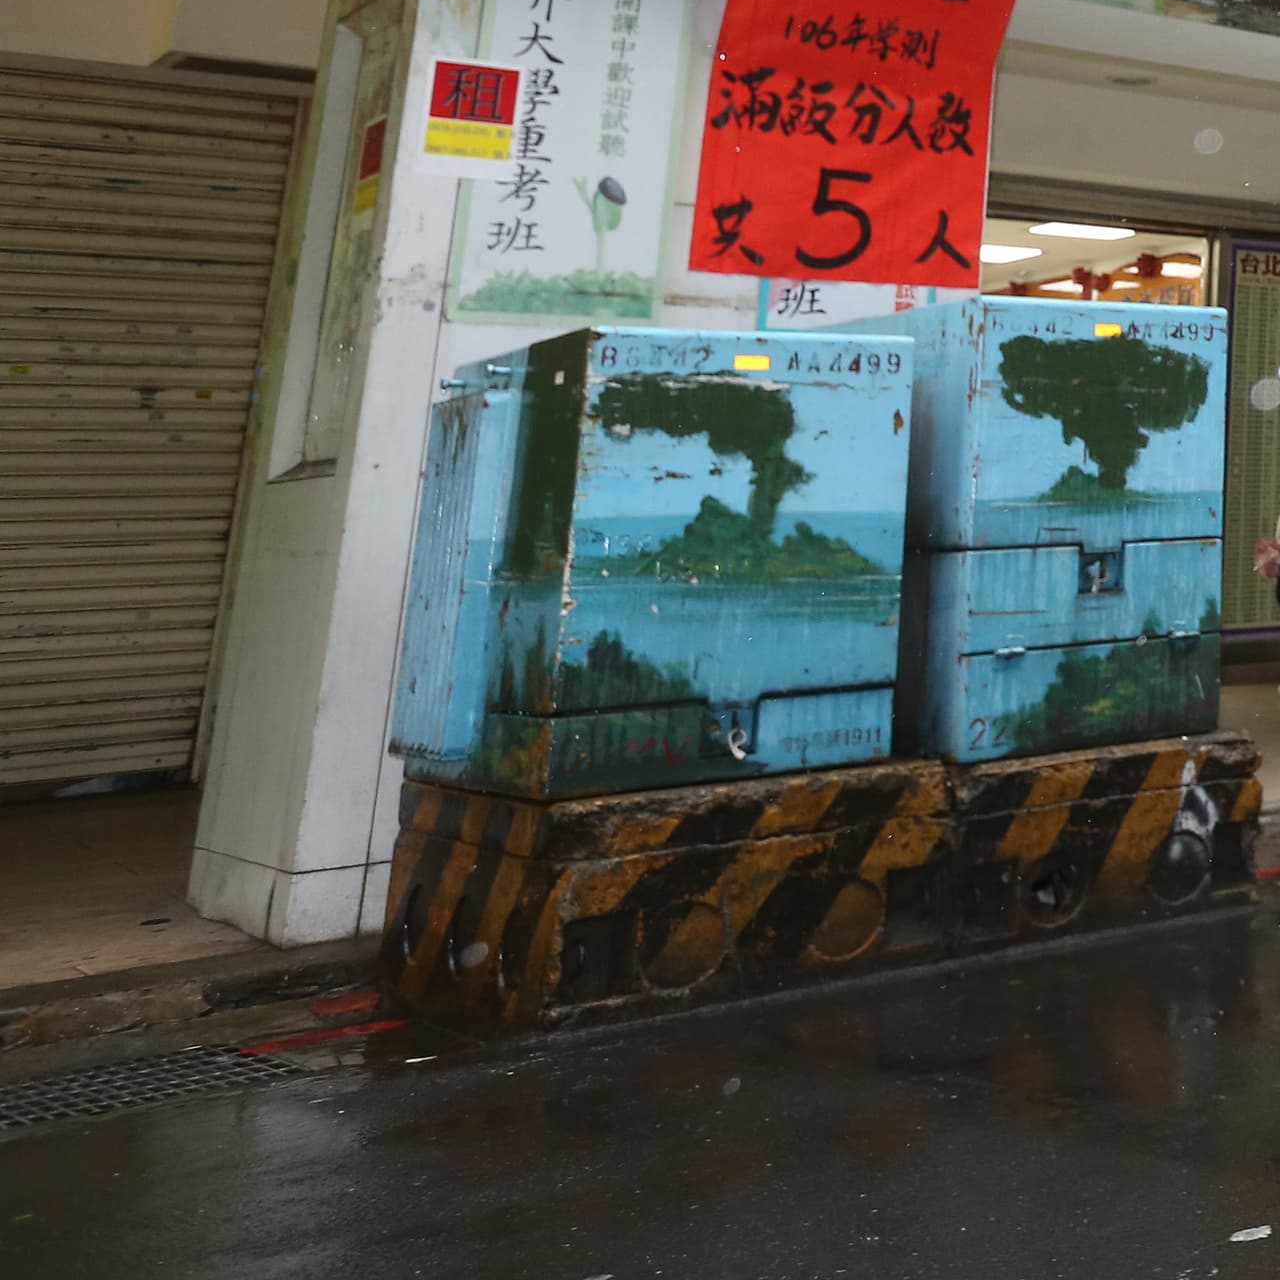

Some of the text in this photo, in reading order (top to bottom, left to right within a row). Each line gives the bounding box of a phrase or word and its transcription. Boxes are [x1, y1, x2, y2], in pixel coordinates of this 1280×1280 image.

[443, 67, 505, 122] 租
[707, 167, 972, 270] 共 5 人
[776, 284, 827, 316] 班
